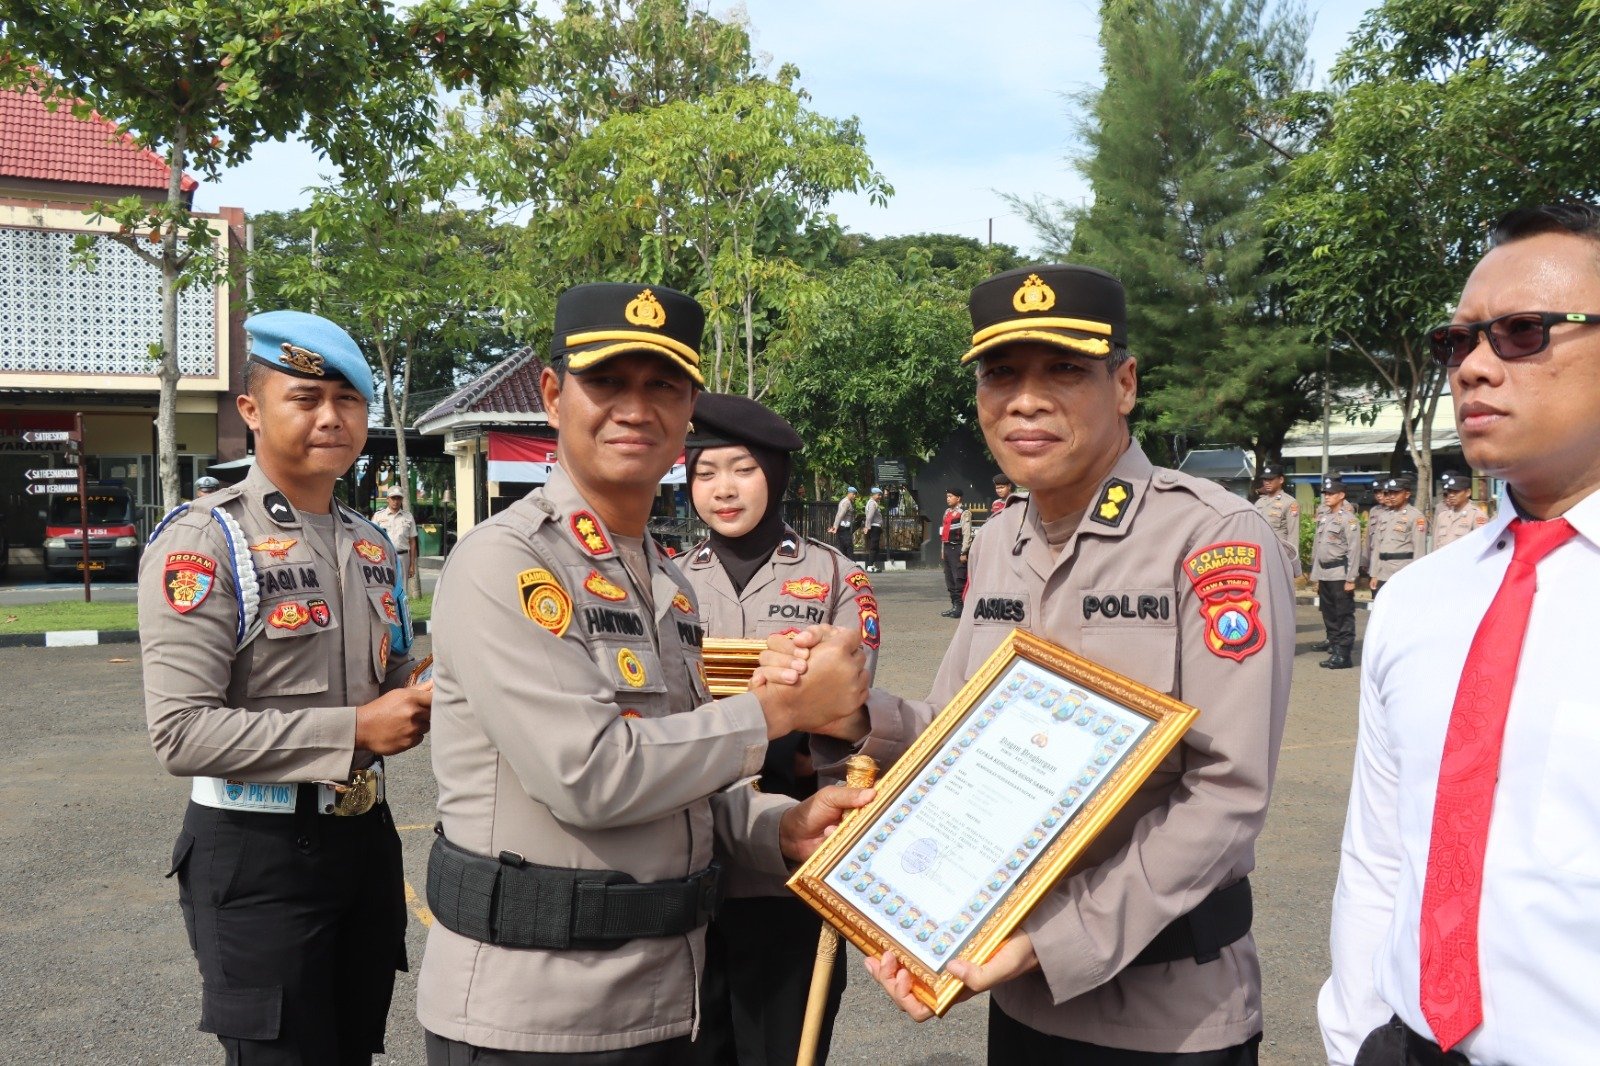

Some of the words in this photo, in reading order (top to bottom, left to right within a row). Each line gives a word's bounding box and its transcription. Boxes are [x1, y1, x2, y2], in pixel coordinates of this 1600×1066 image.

[169, 554, 212, 569] PROPAM
[1189, 546, 1257, 570] POLRES
[1197, 557, 1252, 574] SAMPANG
[299, 567, 320, 588] AR
[768, 604, 825, 624] POLRI
[973, 597, 1025, 622] ARIES
[1082, 595, 1170, 620] POLRI
